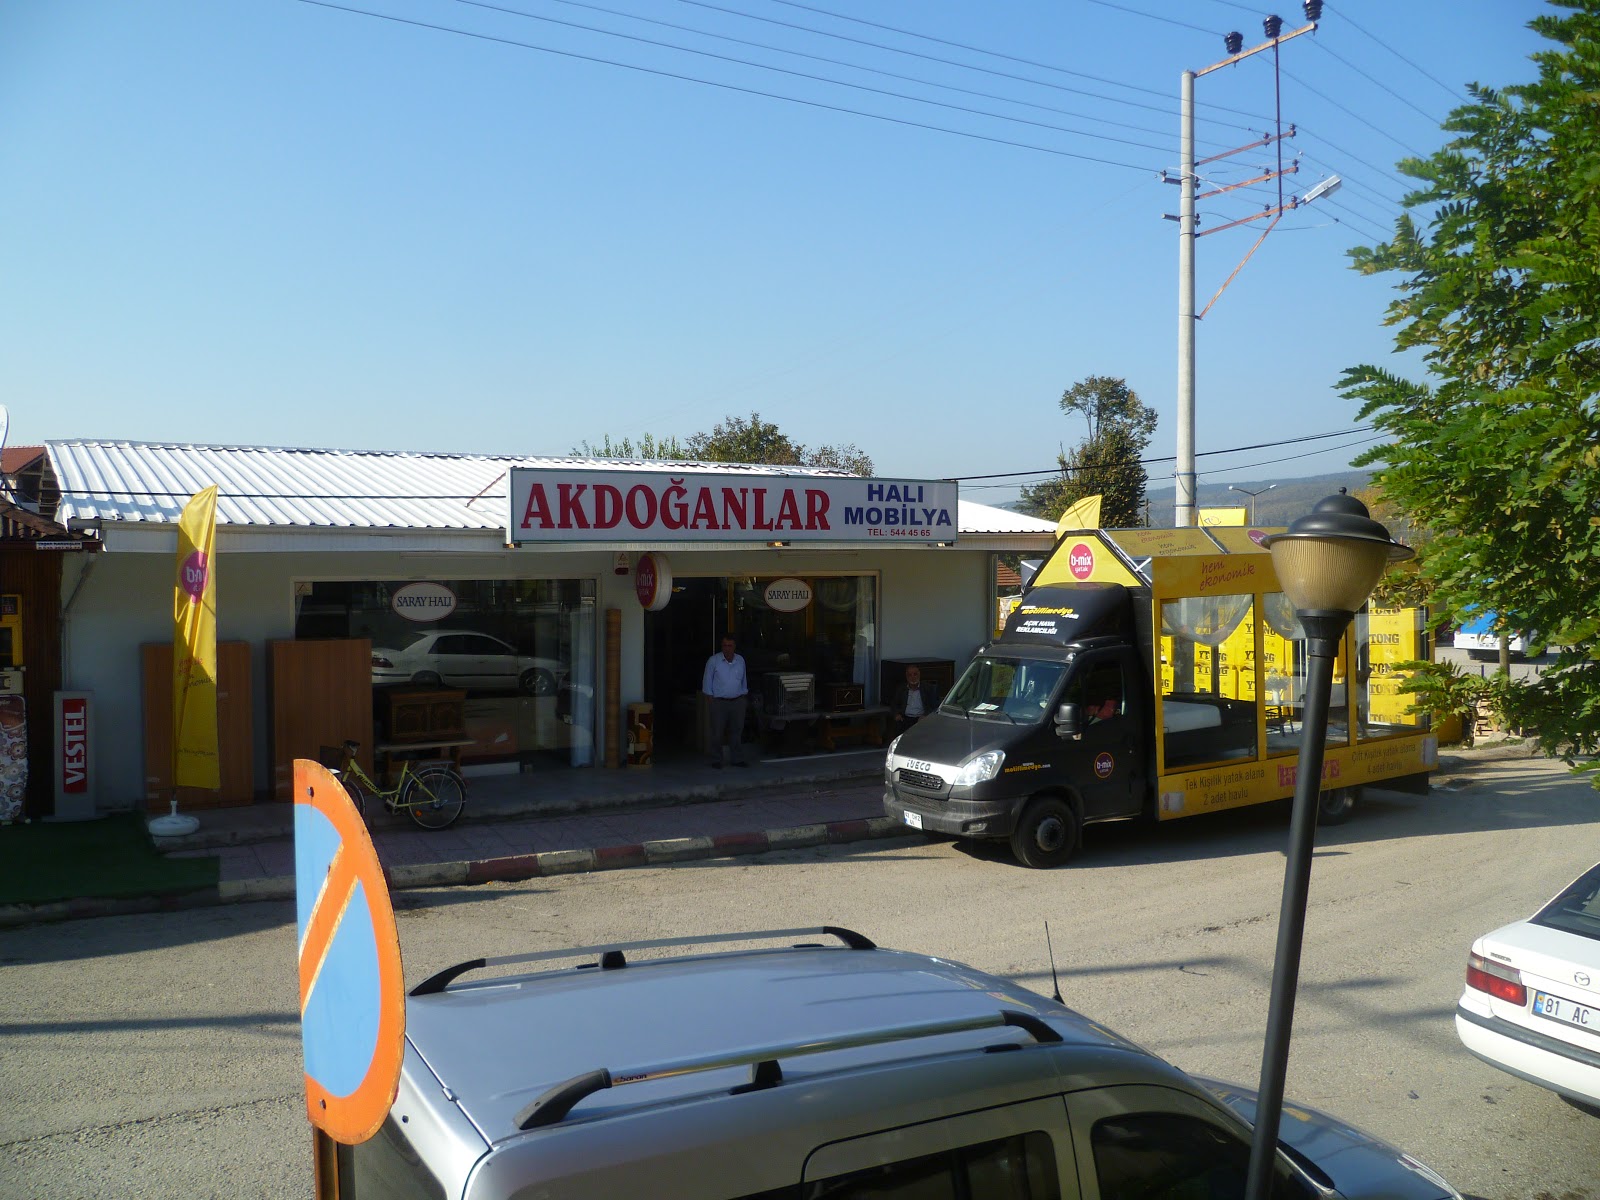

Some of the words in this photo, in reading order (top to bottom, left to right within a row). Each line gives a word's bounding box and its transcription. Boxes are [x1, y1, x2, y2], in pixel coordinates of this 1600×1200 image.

[521, 477, 831, 531] AKDOĞANLAR
[867, 484, 924, 503] HALI
[844, 504, 952, 527] MOBİLYA
[1070, 553, 1092, 567] b-mix
[1202, 560, 1225, 574] hem
[1200, 563, 1256, 591] ekonomik
[397, 596, 428, 607] SARAY
[768, 590, 790, 600] SARAY
[65, 706, 85, 785] VESTEL
[1185, 778, 1198, 791] Tek
[1200, 775, 1221, 790] Kişilik
[1224, 773, 1243, 787] yatak
[1245, 768, 1265, 781] alana
[1203, 793, 1209, 805] 2
[1210, 791, 1227, 805] adet
[1228, 787, 1249, 802] havlu
[1545, 998, 1560, 1016] 81
[1571, 1006, 1590, 1025] AC
